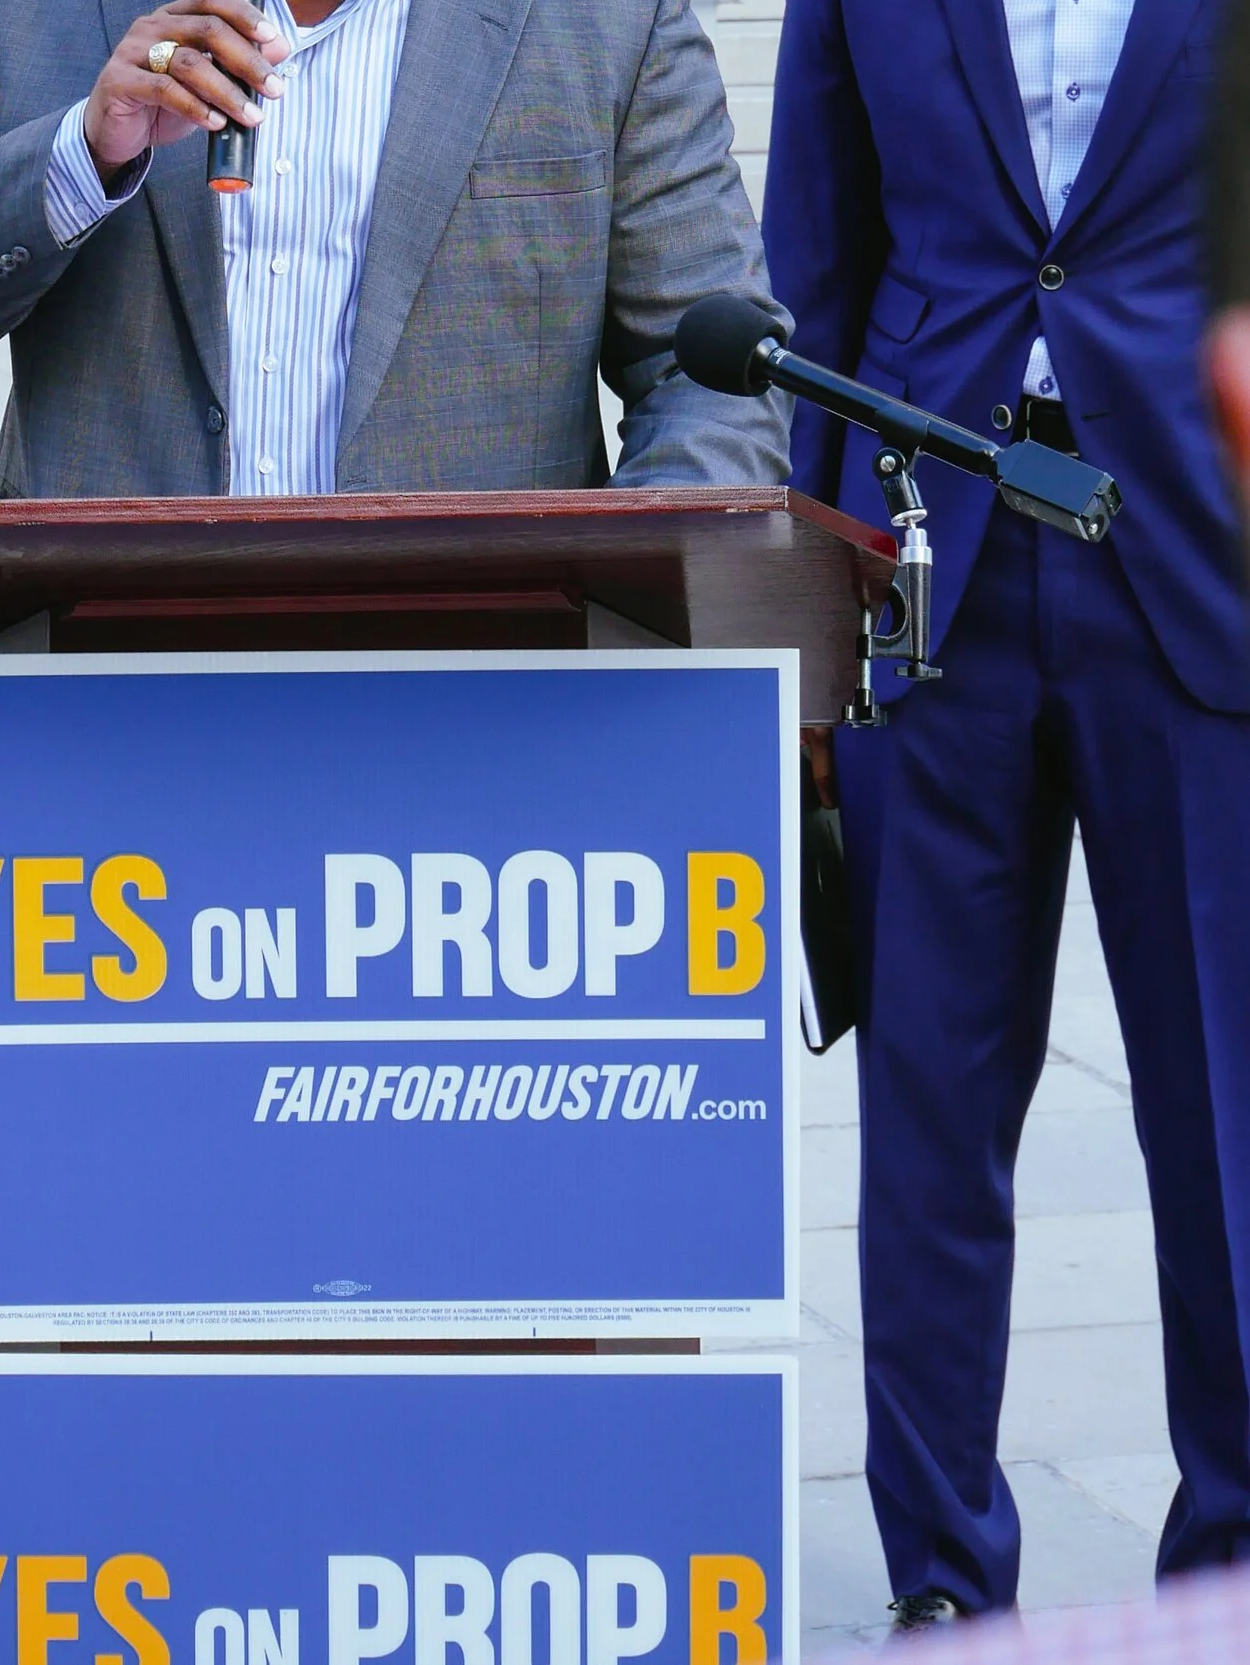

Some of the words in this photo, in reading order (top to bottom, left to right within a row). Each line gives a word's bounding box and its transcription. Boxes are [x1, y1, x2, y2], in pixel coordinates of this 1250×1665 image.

[192, 907, 297, 1001] ON
[325, 850, 665, 999] PROP
[688, 851, 766, 996] B
[253, 1063, 767, 1123] FAIRFORHOUSTON.com
[195, 1608, 299, 1665] ON
[329, 1552, 667, 1665] PROP
